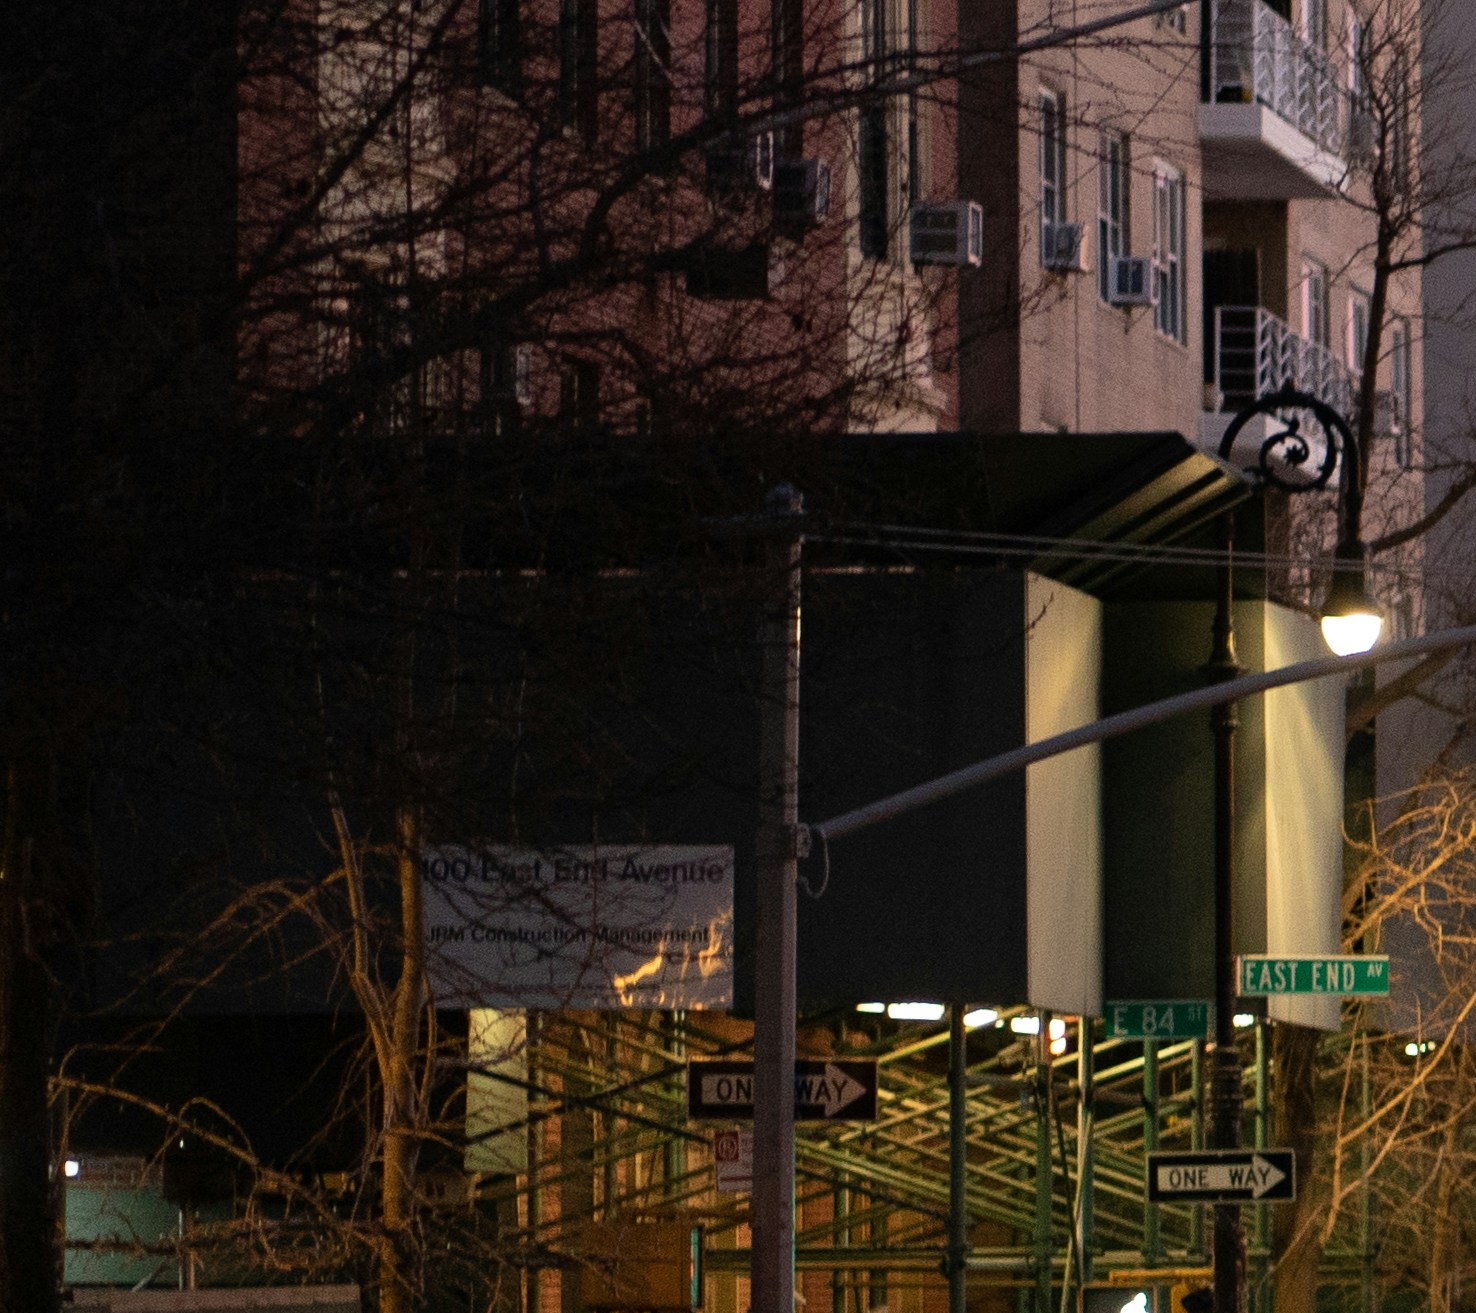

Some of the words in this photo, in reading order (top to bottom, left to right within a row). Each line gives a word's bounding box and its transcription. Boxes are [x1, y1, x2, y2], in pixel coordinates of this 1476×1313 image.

[622, 858, 724, 884] Avenue
[471, 926, 586, 943] Construction
[597, 926, 709, 946] Management
[1245, 962, 1299, 990] EAST
[1312, 962, 1356, 990] END
[1367, 963, 1383, 978] AV
[1113, 1006, 1129, 1035] E
[1142, 1006, 1175, 1035] 84
[716, 1078, 753, 1102] ON
[795, 1078, 848, 1102] WAY
[1169, 1168, 1210, 1188] ONE
[1229, 1167, 1271, 1188] WAY
